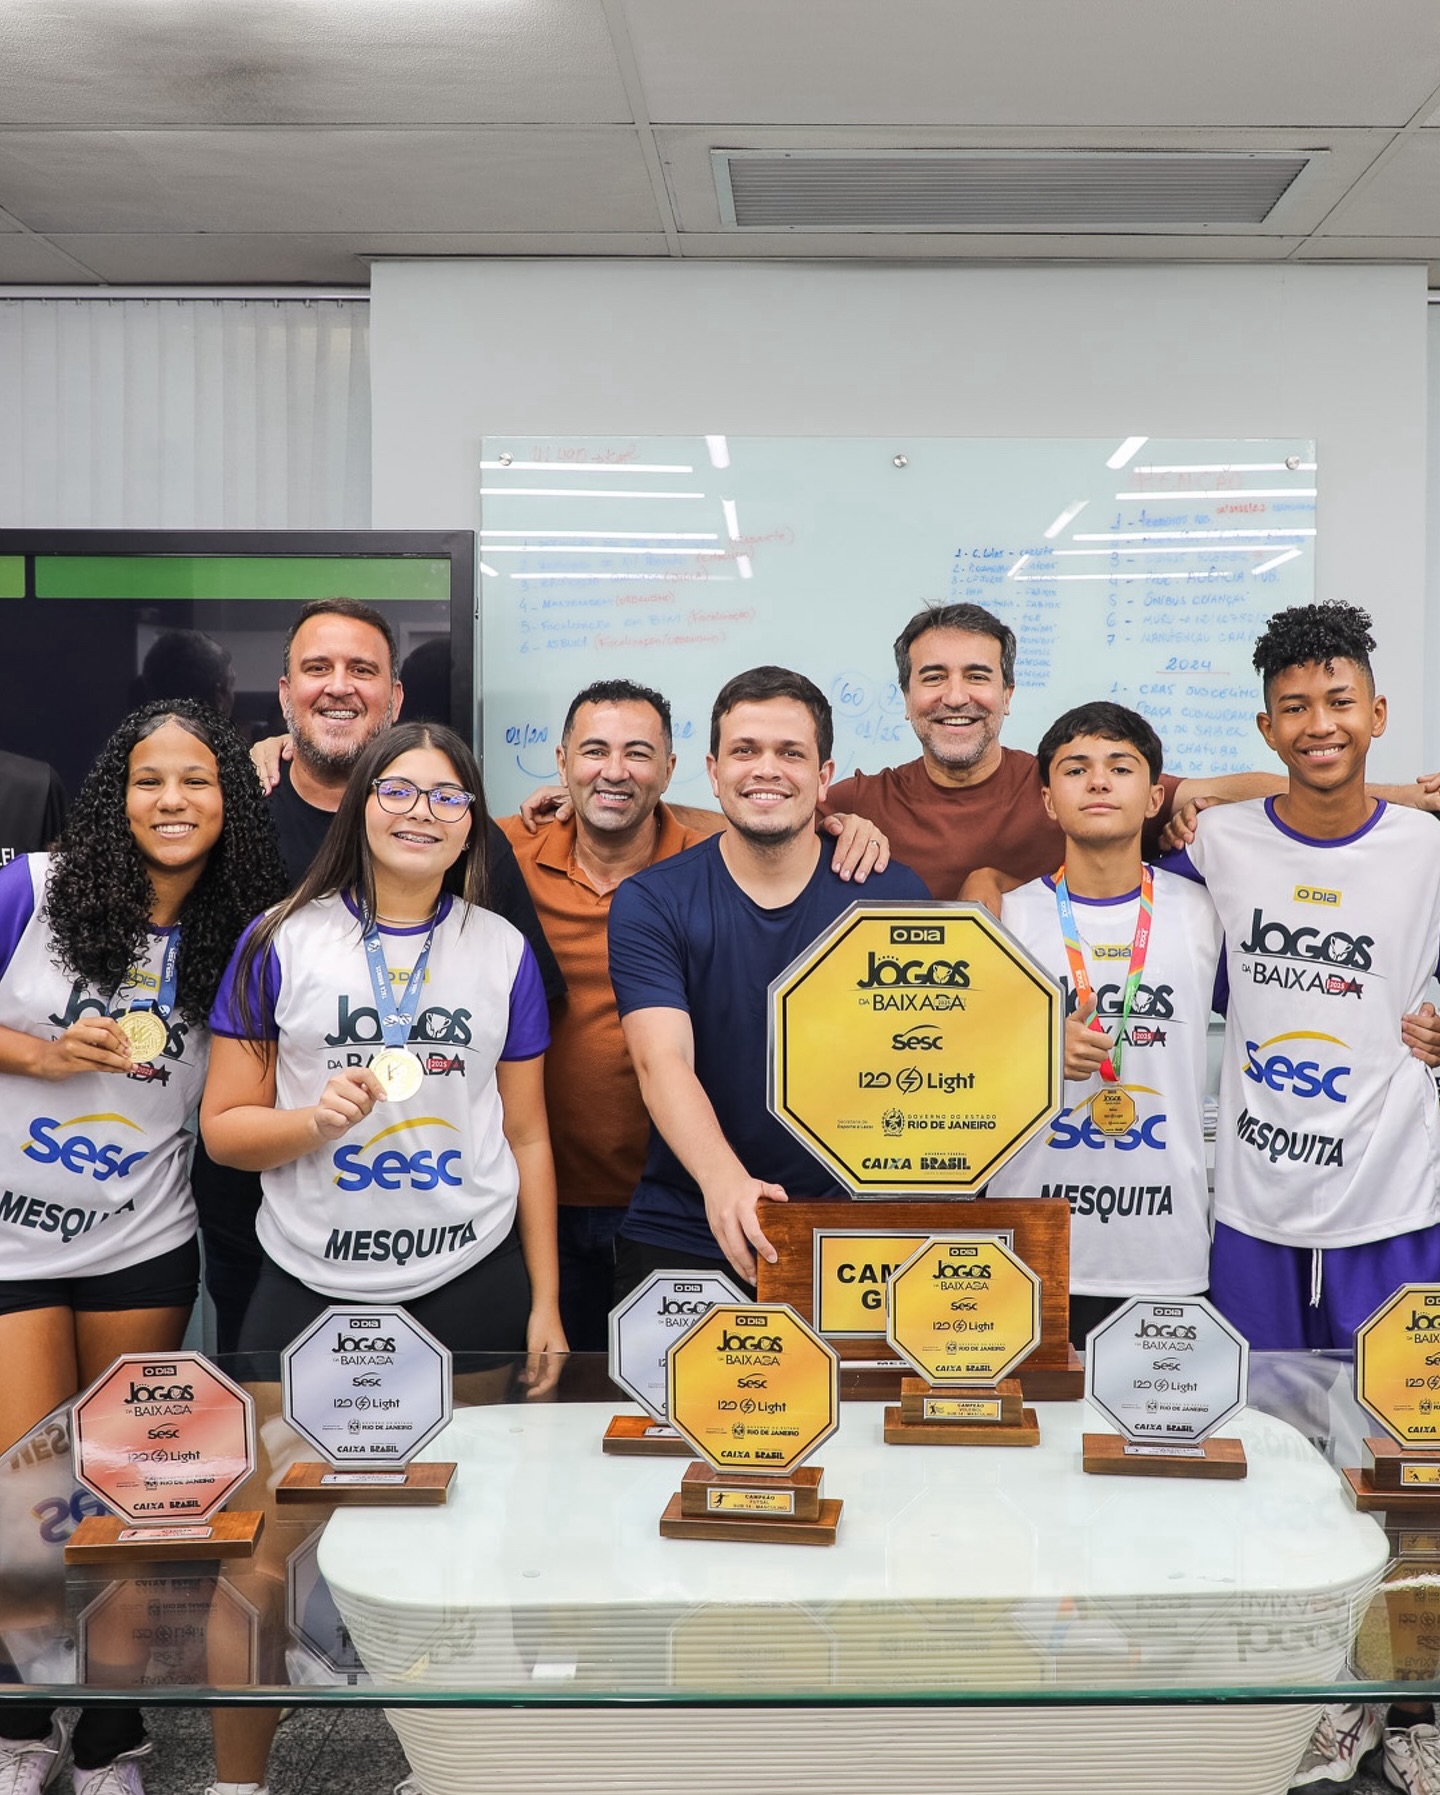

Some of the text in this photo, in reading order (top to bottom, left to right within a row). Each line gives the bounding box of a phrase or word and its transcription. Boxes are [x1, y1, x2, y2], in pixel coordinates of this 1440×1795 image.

[1166, 657, 1212, 671] 2024
[840, 683, 865, 706] 60
[1139, 684, 1176, 696] CRAS
[1297, 888, 1310, 900] O
[893, 929, 906, 941] O
[1240, 908, 1375, 971] JOGOS
[857, 951, 970, 988] JOGOS
[1242, 962, 1363, 999] DA BAIXADA
[873, 994, 967, 1011] BAIXADA
[324, 994, 473, 1046] JOOS
[891, 1032, 943, 1050] Sesc
[328, 1059, 343, 1069] DA
[1244, 1041, 1351, 1103] Sesc
[927, 1072, 975, 1094] Light
[908, 1121, 997, 1130] RIO DE JANEIRO
[1237, 1107, 1344, 1167] MESQUITA
[333, 1145, 462, 1191] Sesc
[861, 1157, 971, 1170] CAIXA BRASIL
[324, 1219, 477, 1266] MESQUITA
[933, 1260, 991, 1279] JOGOS
[657, 1296, 714, 1315] JOGO
[969, 1321, 994, 1332] Light
[1135, 1319, 1197, 1340] JOGOS
[332, 1333, 396, 1353] JOGOS
[717, 1330, 783, 1352] JOGOS
[726, 1354, 780, 1366] BAIXADA
[124, 1382, 195, 1404] JOGOS
[1171, 1381, 1198, 1393] Light
[134, 1404, 192, 1417] BAIXADA
[373, 1399, 400, 1410] Light
[758, 1401, 786, 1414] Light
[148, 1428, 180, 1439] Sesc
[1135, 1423, 1194, 1432] CAIXA BRASIL
[1408, 1426, 1437, 1434] CAIXA
[337, 1445, 399, 1453] CAIXA BRASIL
[755, 1451, 785, 1459] BRASIL
[170, 1450, 200, 1463] Light
[133, 1500, 201, 1510] CAIXA BRASIL
